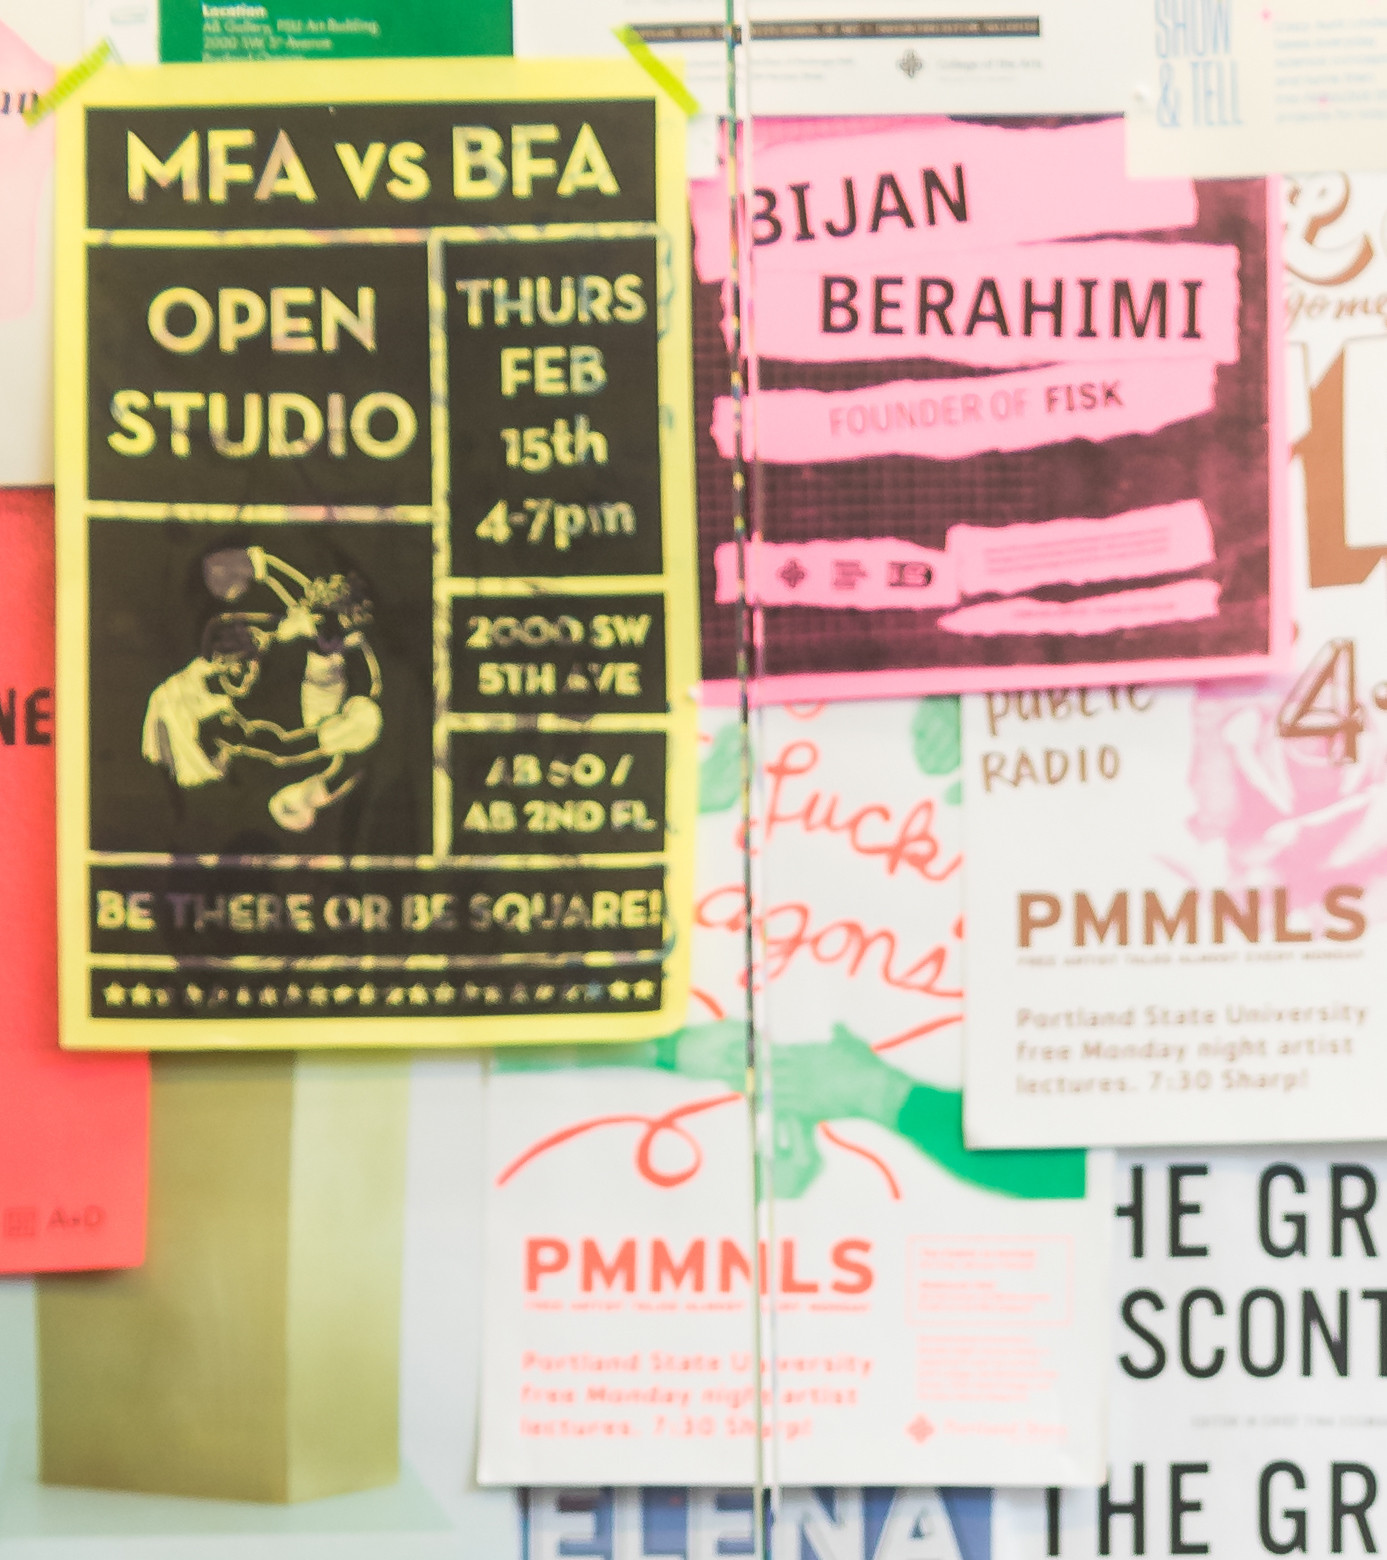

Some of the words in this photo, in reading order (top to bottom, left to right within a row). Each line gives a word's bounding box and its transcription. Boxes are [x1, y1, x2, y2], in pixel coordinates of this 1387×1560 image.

[125, 129, 316, 205] MFA
[451, 124, 620, 198] BFA
[752, 163, 970, 246] BIJAN
[148, 287, 378, 353] OPEN
[456, 276, 647, 328] THURS
[821, 274, 1206, 341] BERAHIMI
[501, 347, 606, 395] FEB
[1044, 380, 1125, 415] FISK
[108, 391, 417, 458] STUDIO
[501, 416, 608, 471] 15th
[476, 497, 636, 548] 4-7pm
[465, 615, 585, 648] 2000
[589, 614, 651, 648] SW
[478, 662, 557, 696] 5TH
[980, 752, 1122, 792] RADIO
[463, 800, 517, 832] AB
[523, 800, 606, 832] 2ND
[96, 891, 155, 931] BE
[167, 891, 314, 934] THERE
[323, 893, 392, 934] OR
[403, 891, 454, 934] BE
[468, 889, 664, 938] SQUARE!
[1015, 884, 1368, 948] PMMNLS
[1015, 1005, 1136, 1029] Portland
[1145, 1004, 1218, 1028] State
[1225, 1001, 1368, 1031] University
[1015, 1038, 1070, 1064] free
[1081, 1036, 1185, 1064] Monday
[1198, 1034, 1268, 1063] night
[1278, 1032, 1354, 1059] artist
[1149, 1069, 1213, 1094] 7:30
[1222, 1067, 1310, 1095] Sharp!
[523, 1236, 876, 1296] PMMNLS
